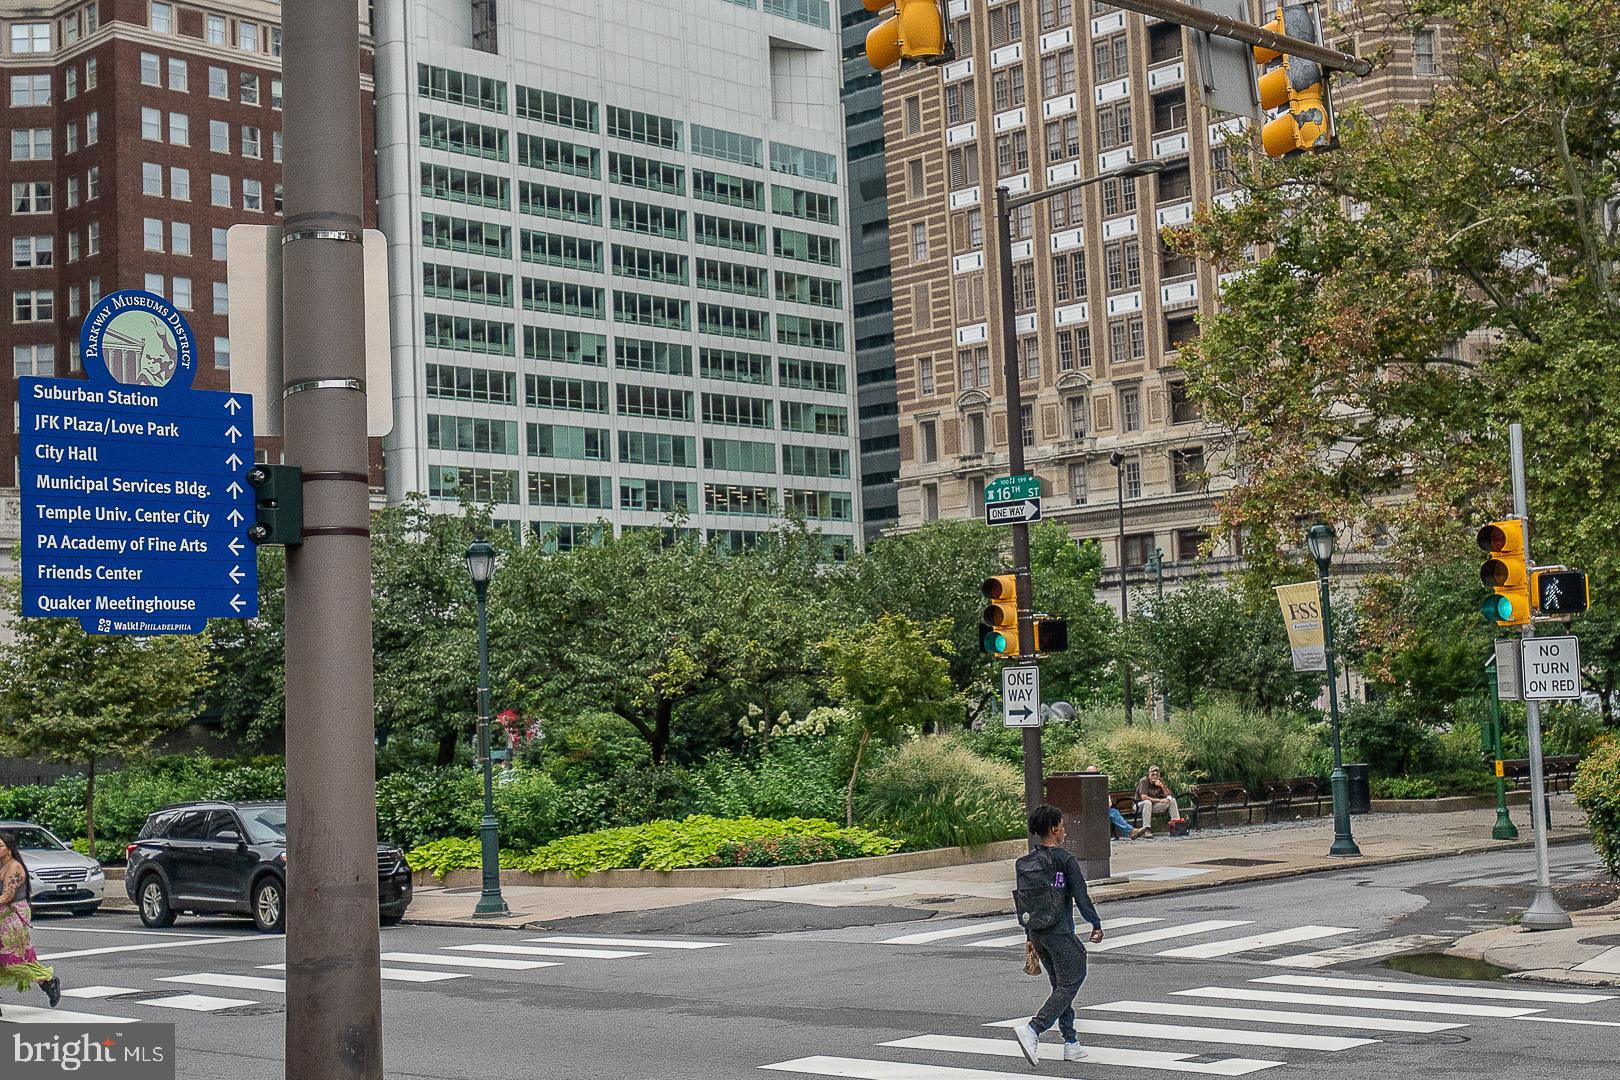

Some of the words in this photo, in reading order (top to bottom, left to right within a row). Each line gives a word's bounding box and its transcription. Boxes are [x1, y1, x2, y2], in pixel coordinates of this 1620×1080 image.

[33, 384, 104, 403] Suburban
[107, 389, 159, 407] Station
[34, 414, 60, 431] JFK
[63, 416, 144, 437] Plaza/Love
[147, 421, 180, 437] Park
[35, 443, 65, 463] City
[68, 445, 98, 462] Hall
[36, 474, 109, 494] Municipal
[112, 477, 172, 495] Services
[175, 480, 211, 499] Bldg.
[1028, 487, 1040, 497] ST
[36, 504, 92, 524] Temple
[95, 506, 132, 522] Univ.
[135, 508, 180, 524] Center
[183, 509, 210, 528] City
[992, 508, 1007, 519] ONE
[1008, 506, 1025, 517] WAY
[37, 534, 58, 549] PA
[61, 534, 127, 554] Academy
[129, 536, 145, 551] of
[147, 536, 177, 553] Fine
[179, 538, 208, 553] Arts
[37, 564, 93, 580] Friends
[95, 565, 143, 581] Center
[37, 594, 92, 612] Quaker
[95, 596, 196, 614] Meetinghouse
[1288, 601, 1319, 621] FSS
[1539, 644, 1560, 657] NO
[1532, 661, 1570, 675] TURN
[1007, 672, 1033, 686] ONE
[1529, 680, 1547, 692] ON
[1552, 679, 1575, 692] RED
[1008, 688, 1033, 702] WAY
